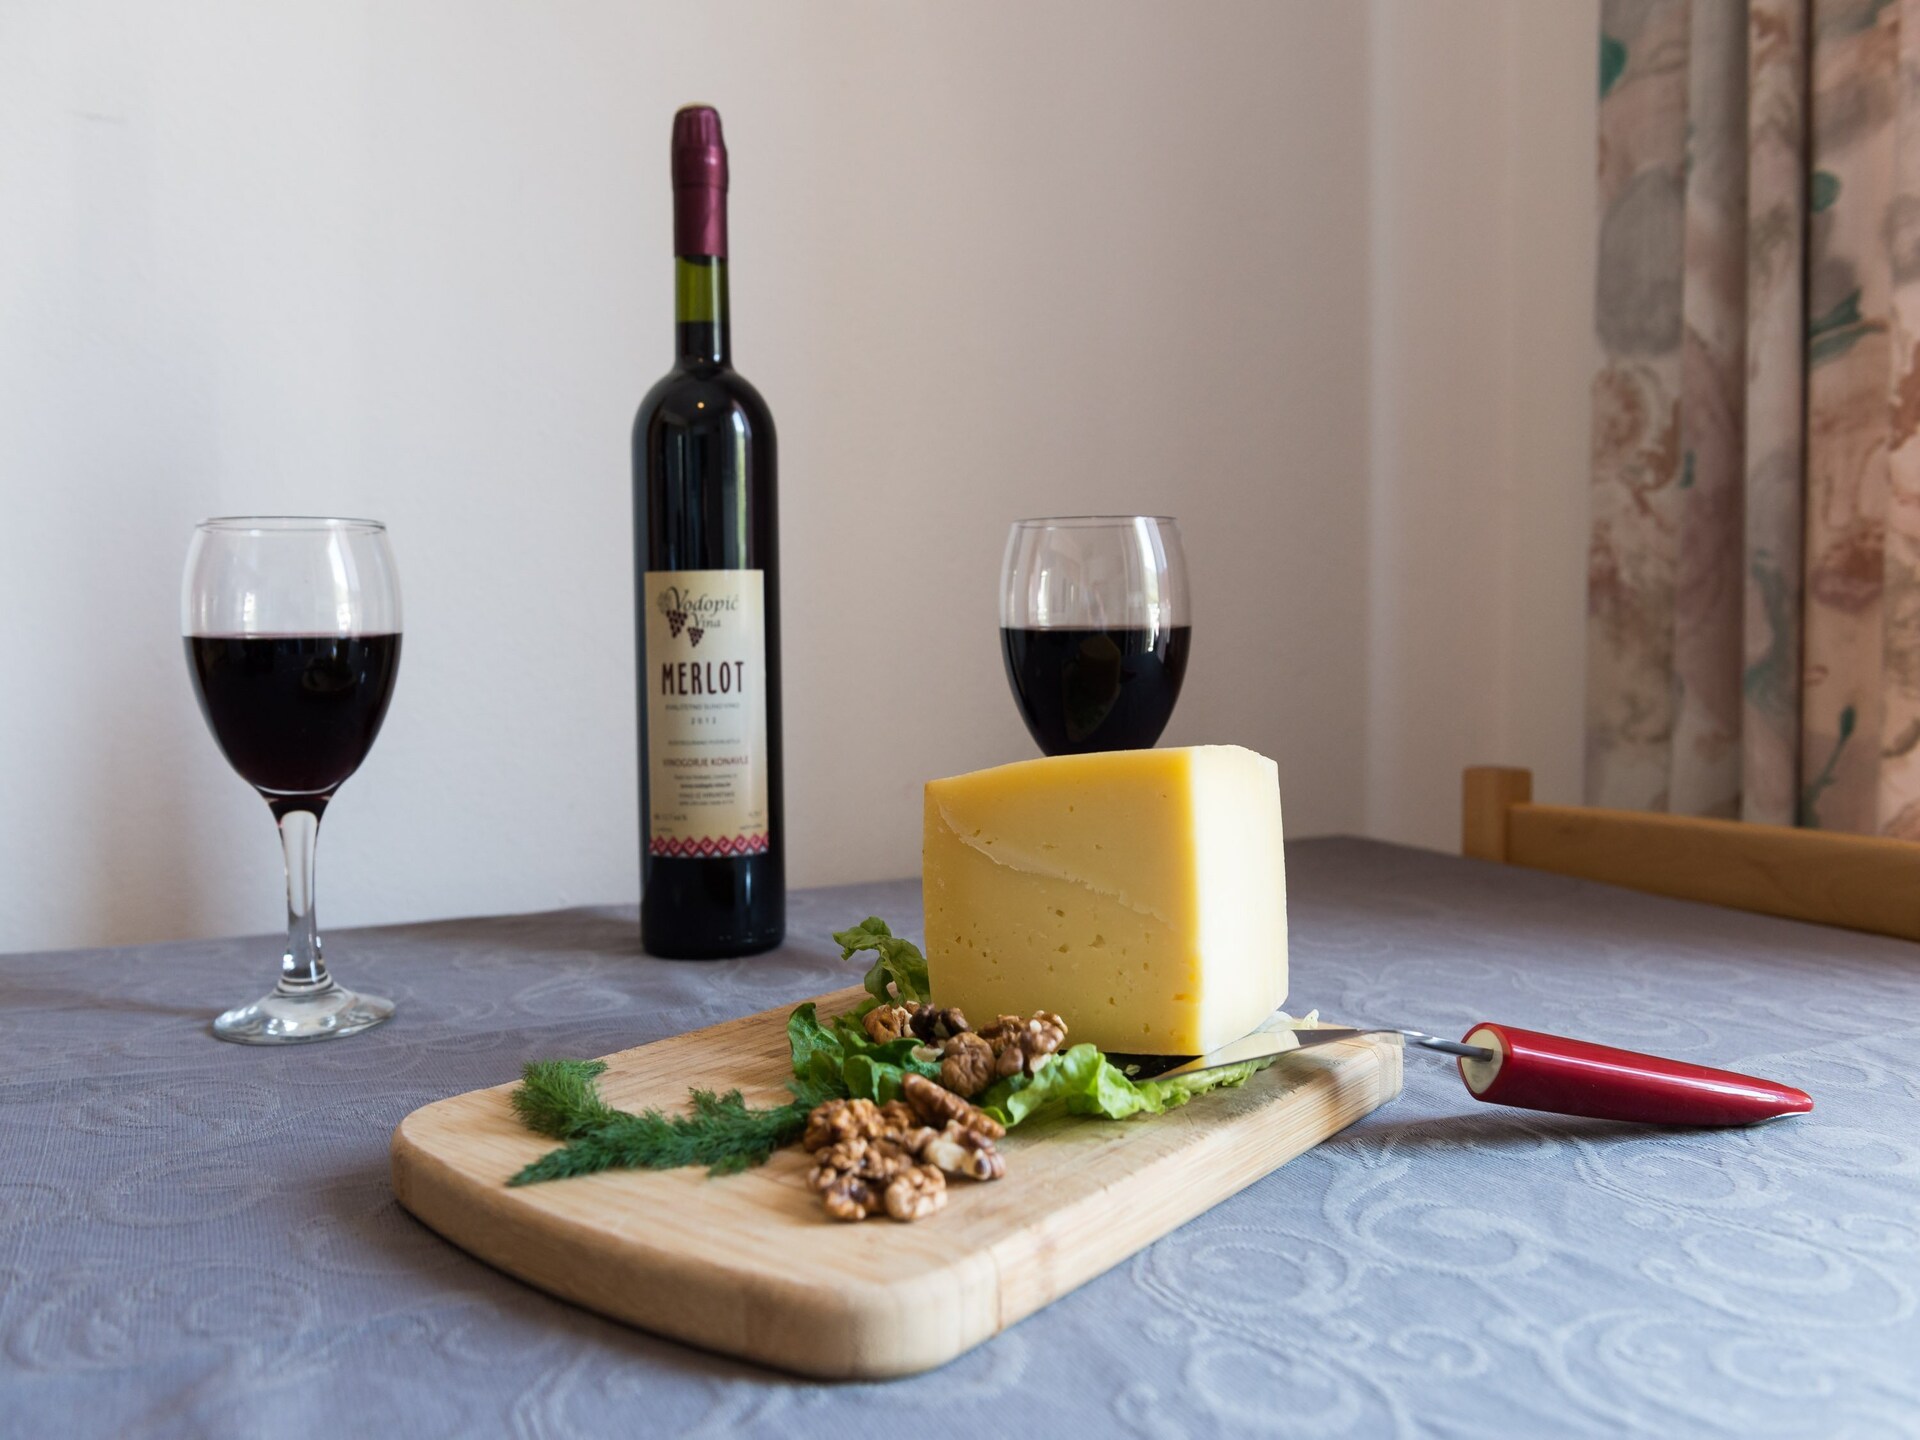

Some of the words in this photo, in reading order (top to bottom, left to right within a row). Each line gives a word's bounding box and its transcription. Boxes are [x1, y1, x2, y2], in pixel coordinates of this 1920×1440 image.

[691, 612, 721, 628] Vina
[661, 661, 745, 695] MERLOT
[663, 757, 708, 768] VINOGORJE
